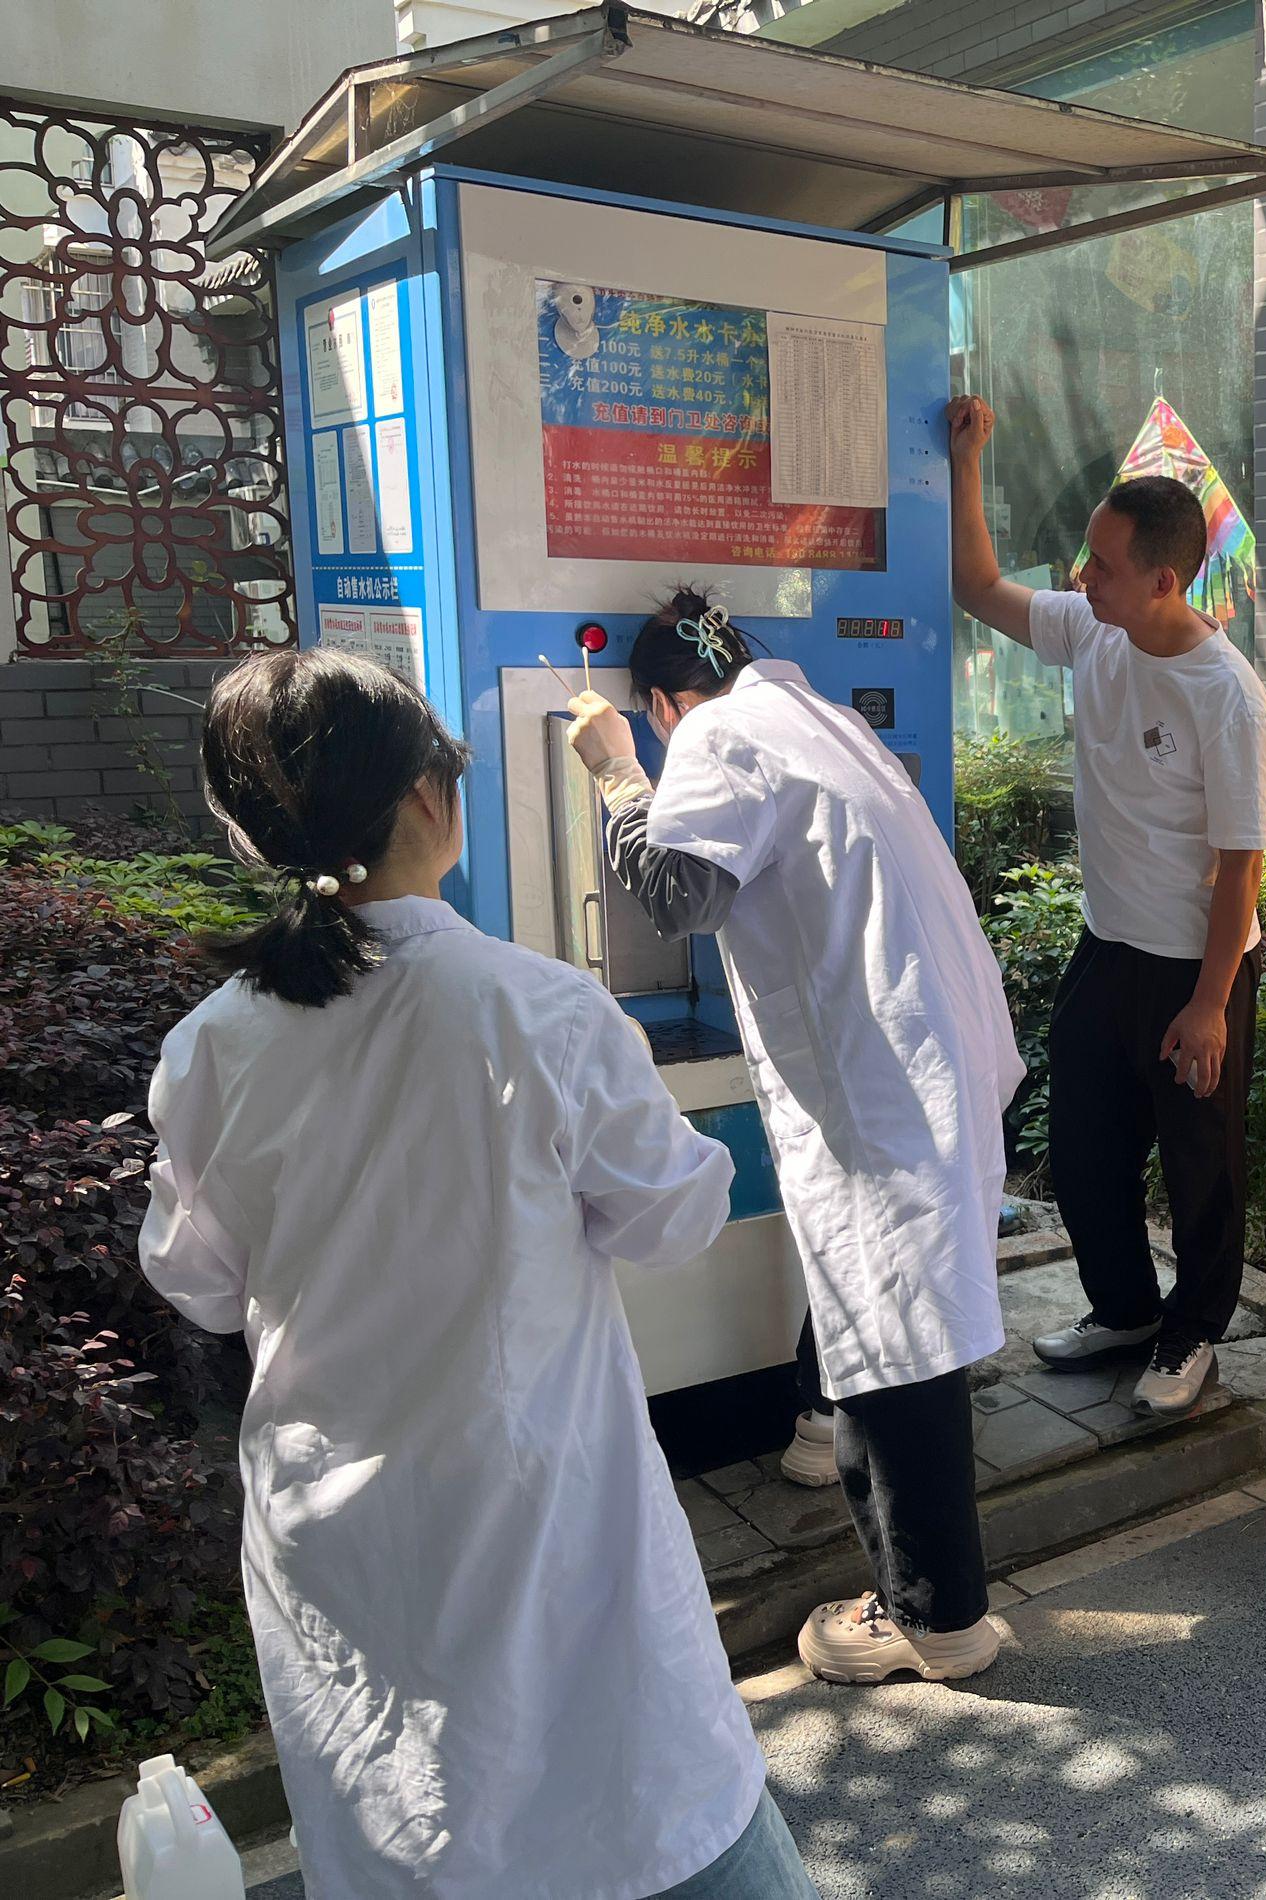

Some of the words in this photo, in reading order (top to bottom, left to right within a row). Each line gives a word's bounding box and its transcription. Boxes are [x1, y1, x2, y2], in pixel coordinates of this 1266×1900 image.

[658, 442, 758, 470] 温馨提示
[336, 575, 399, 600] 自动售水机公示栏
